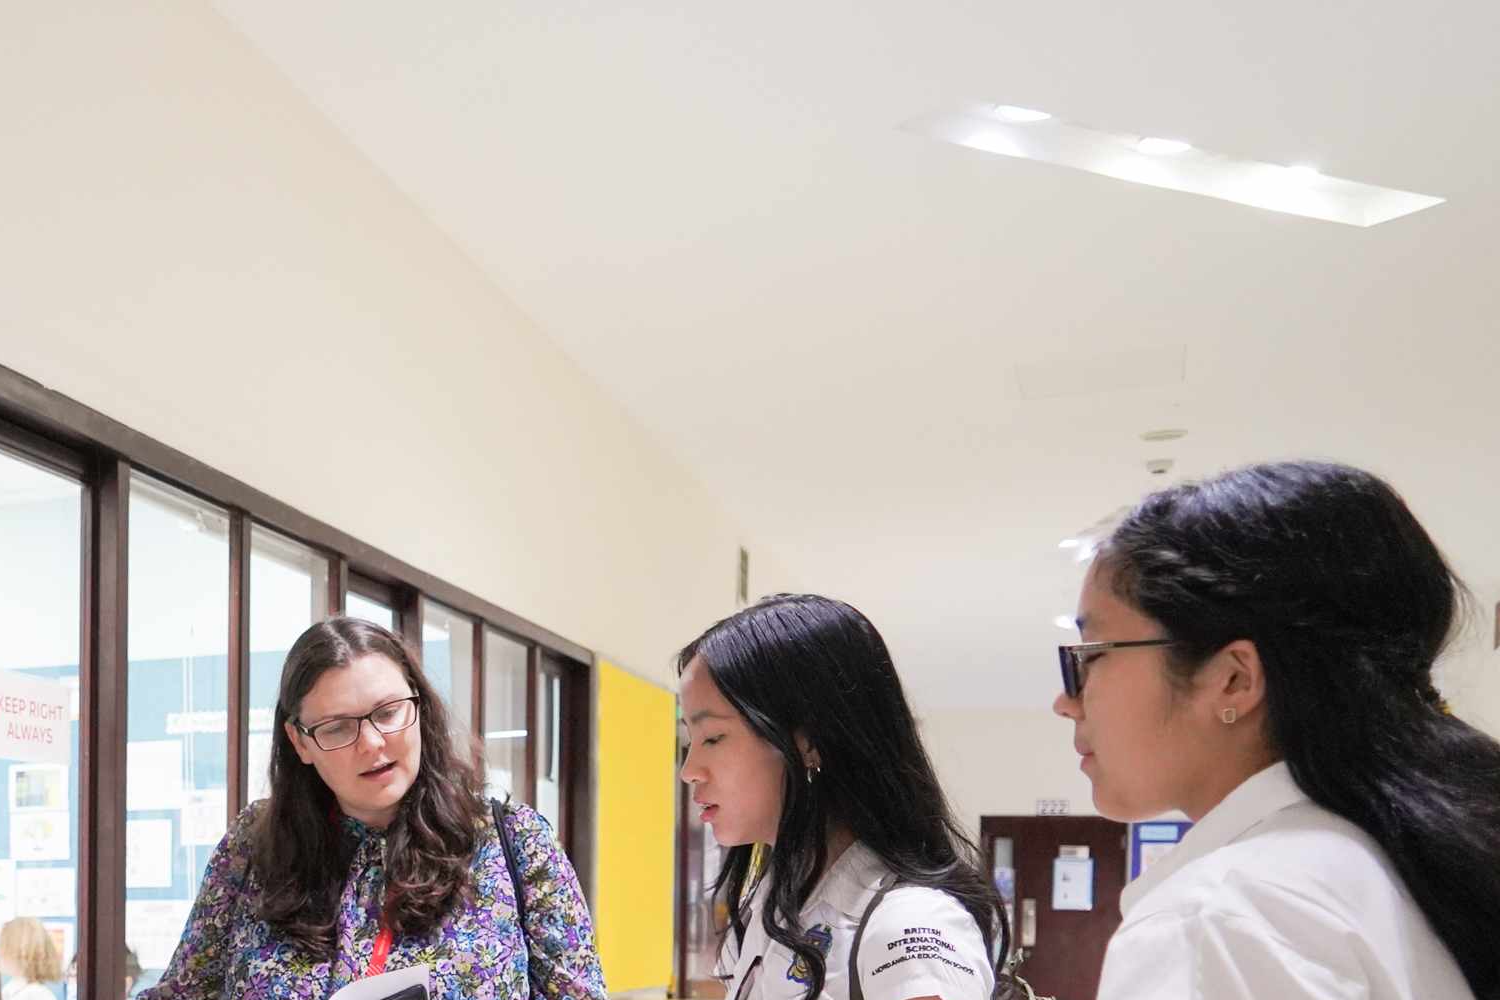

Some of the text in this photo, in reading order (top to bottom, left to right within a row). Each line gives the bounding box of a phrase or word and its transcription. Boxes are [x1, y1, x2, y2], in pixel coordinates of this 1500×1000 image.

[29, 699, 64, 721] RIGHT
[6, 721, 53, 745] ALWAYS
[903, 927, 941, 936] BRITISH
